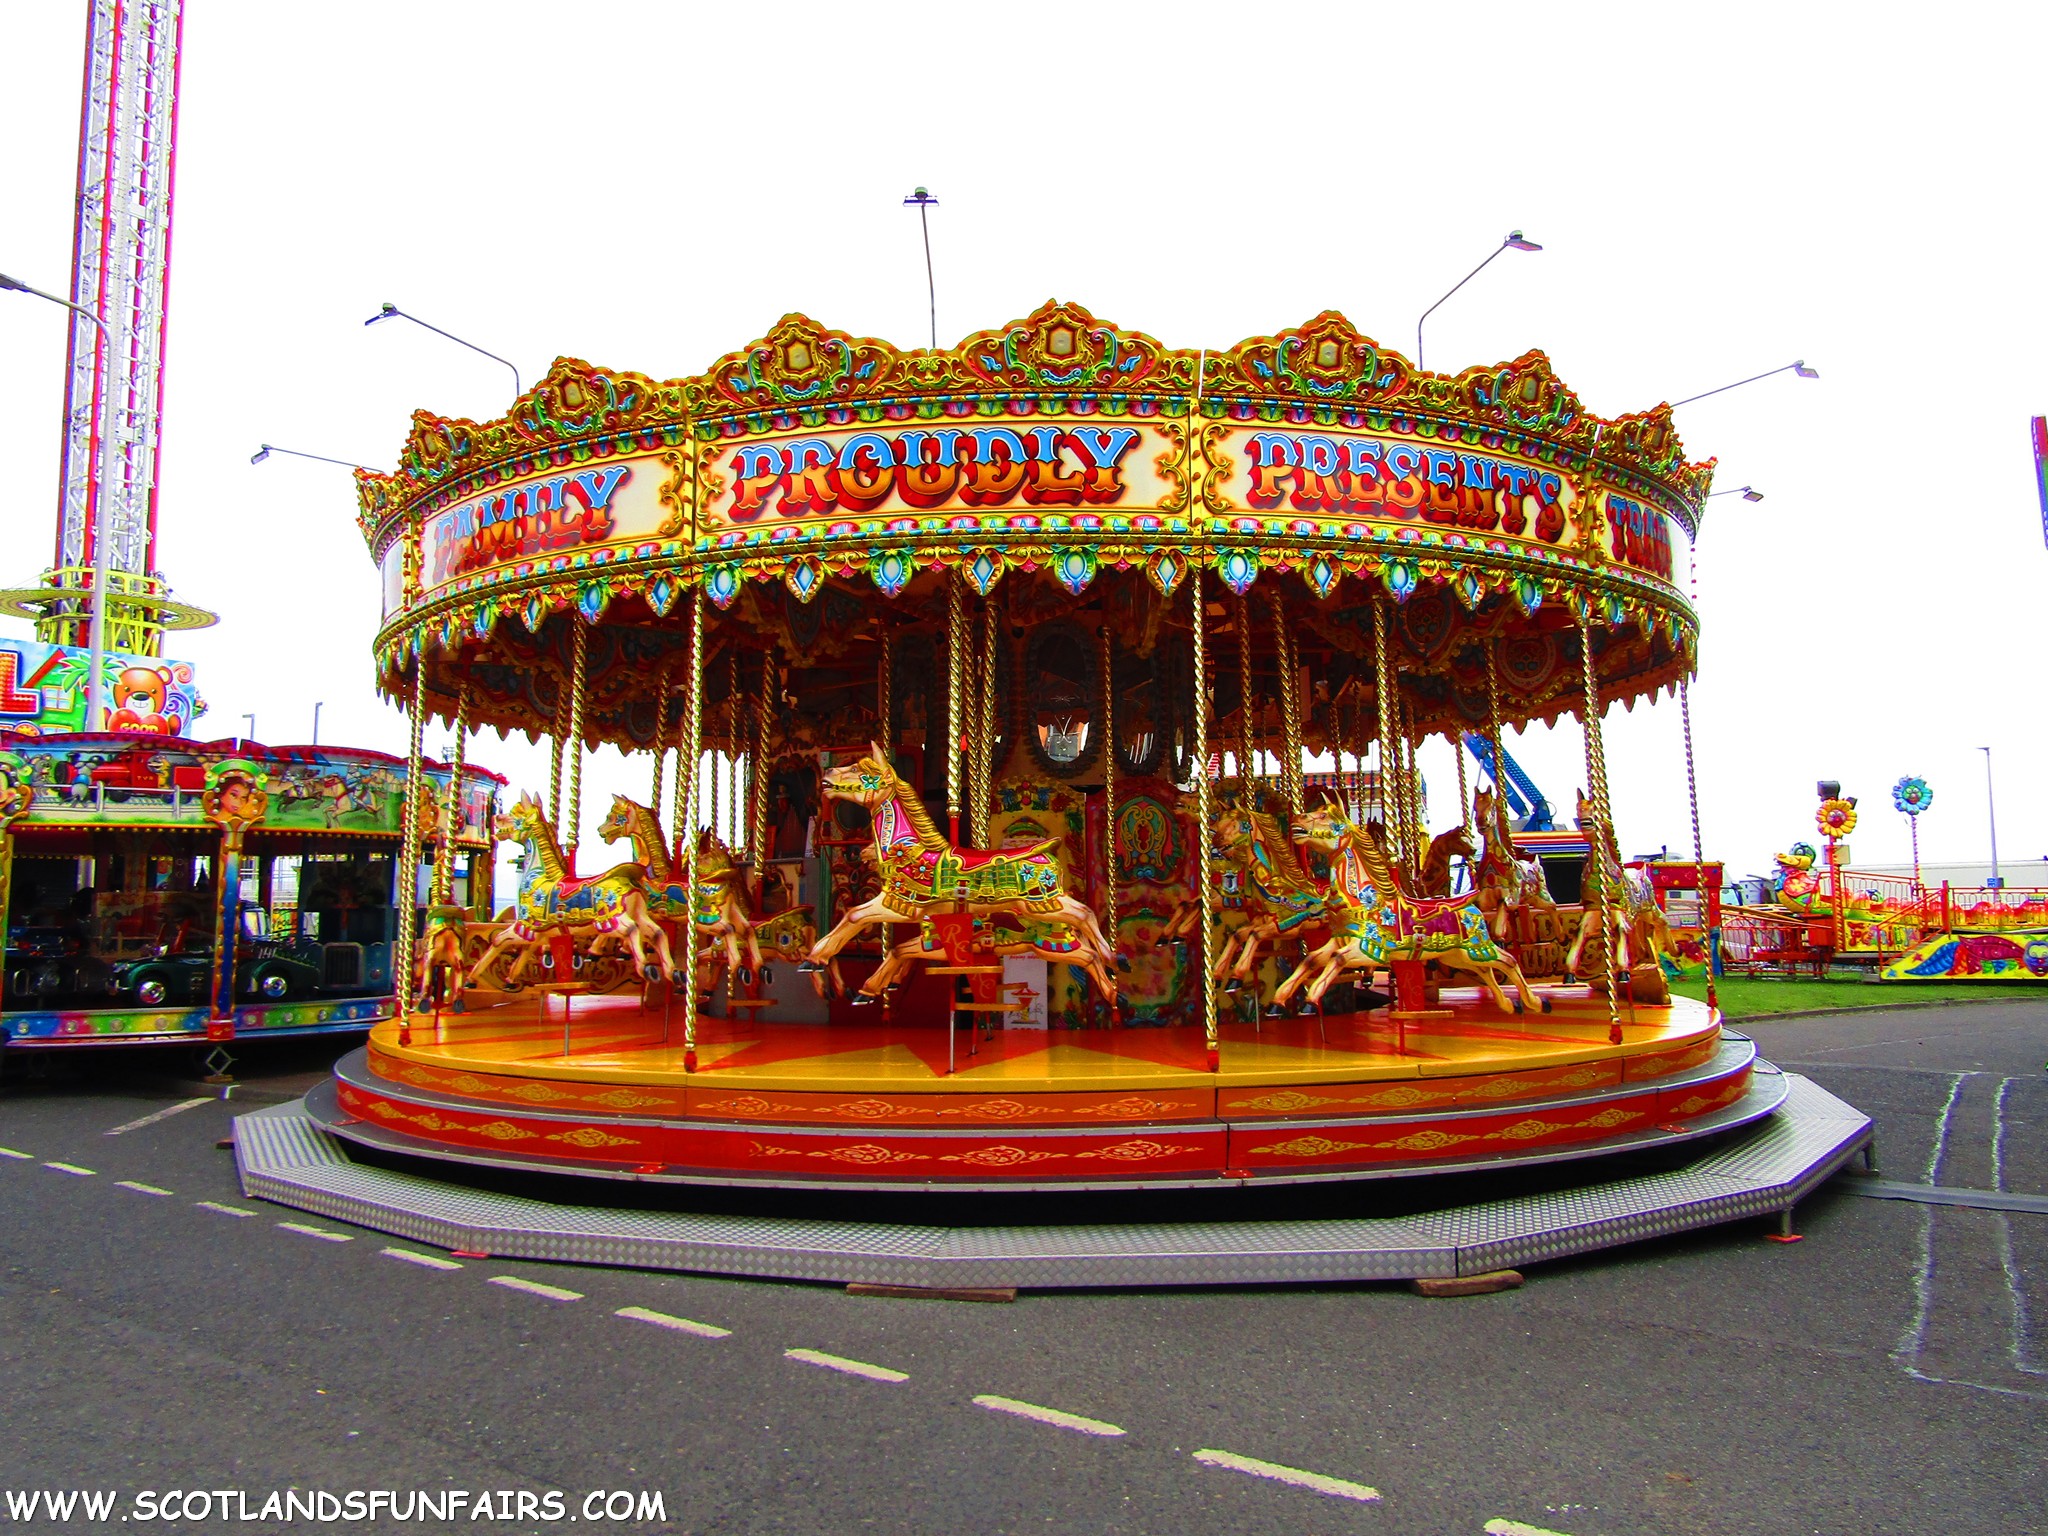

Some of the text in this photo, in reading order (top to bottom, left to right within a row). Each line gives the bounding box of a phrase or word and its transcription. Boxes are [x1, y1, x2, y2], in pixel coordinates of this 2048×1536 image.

[434, 466, 629, 580] FAMILY
[728, 427, 1141, 520] PROUDLY
[1245, 432, 1564, 540] PRESENT'S
